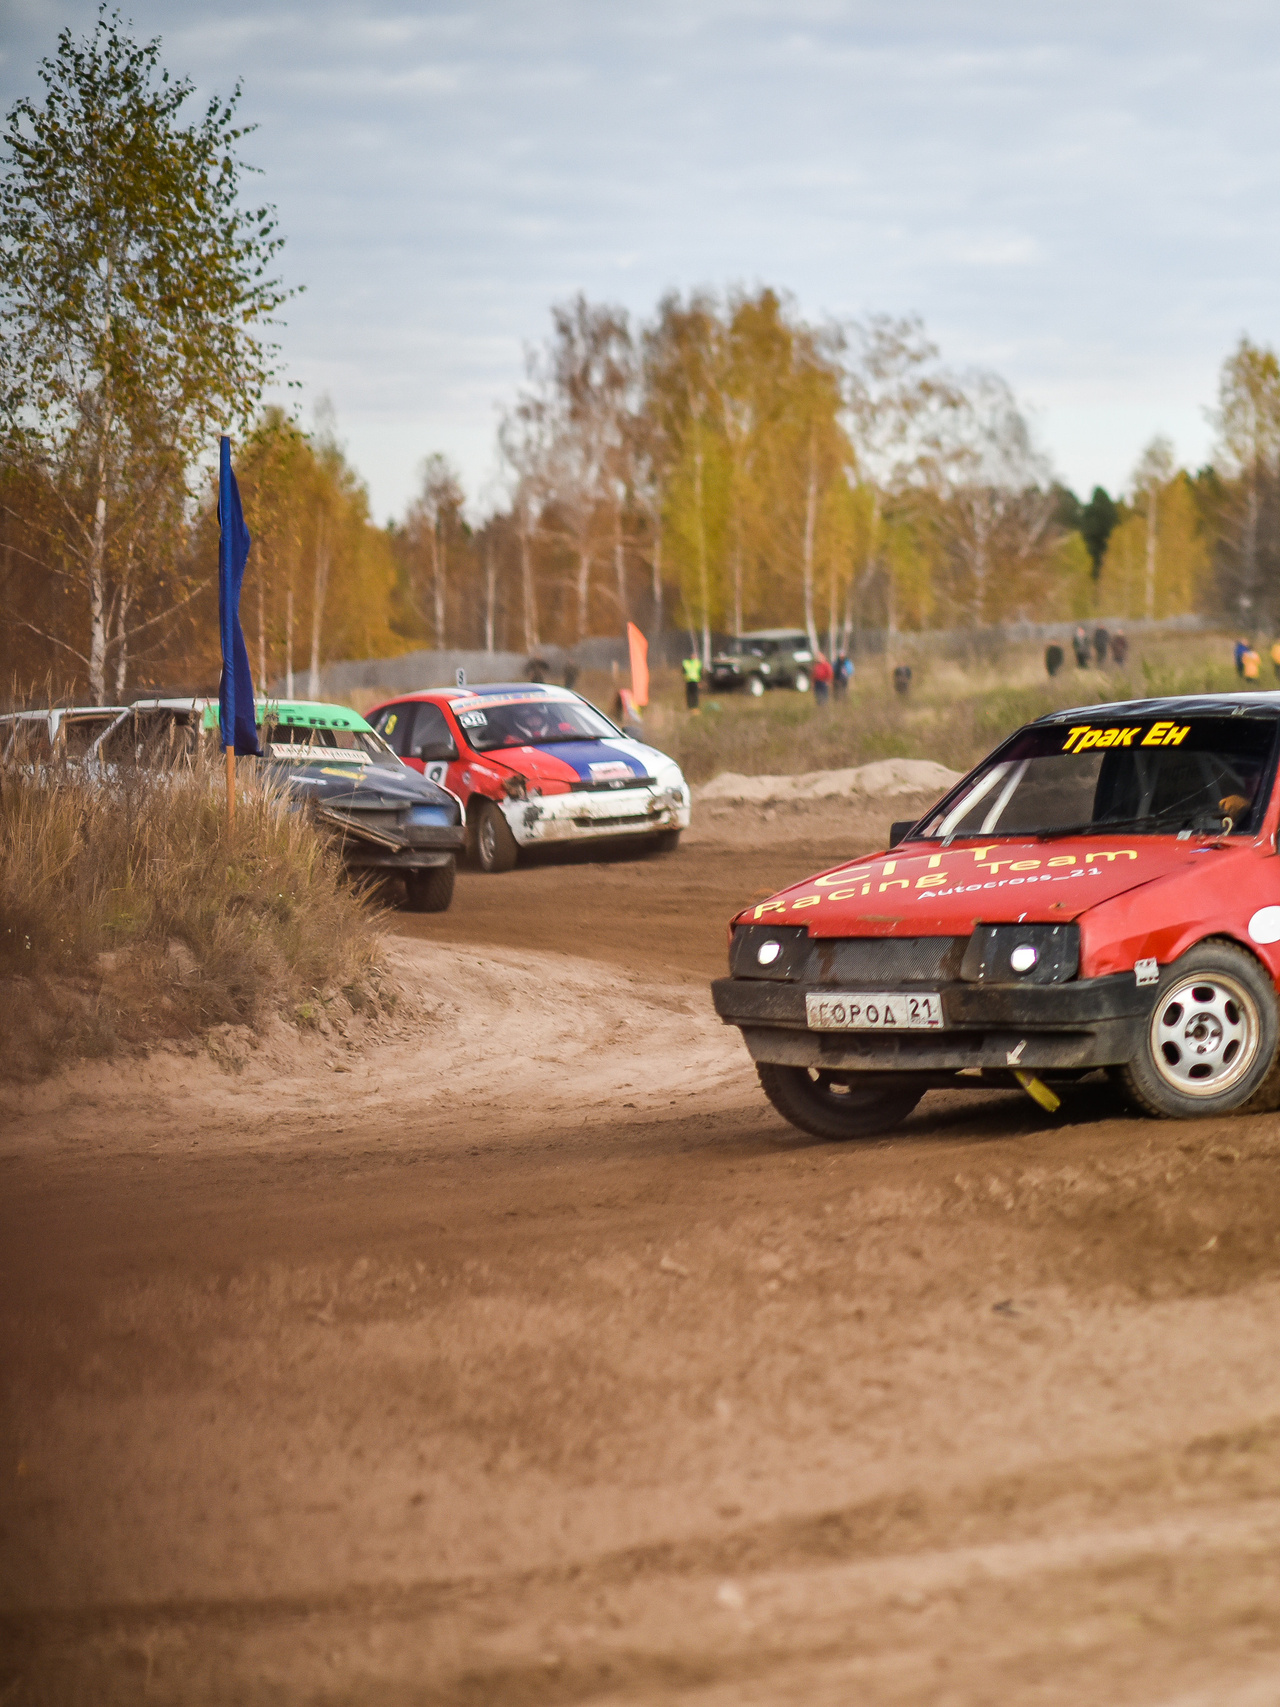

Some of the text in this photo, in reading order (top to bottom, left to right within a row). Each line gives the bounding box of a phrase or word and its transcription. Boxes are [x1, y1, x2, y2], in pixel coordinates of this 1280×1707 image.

[1062, 721, 1191, 754] Трак Ен
[814, 845, 999, 886] CITY
[753, 849, 1138, 920] Racing Team
[917, 867, 1102, 900] Autocross_21
[819, 998, 932, 1025] ГОРОД 21
